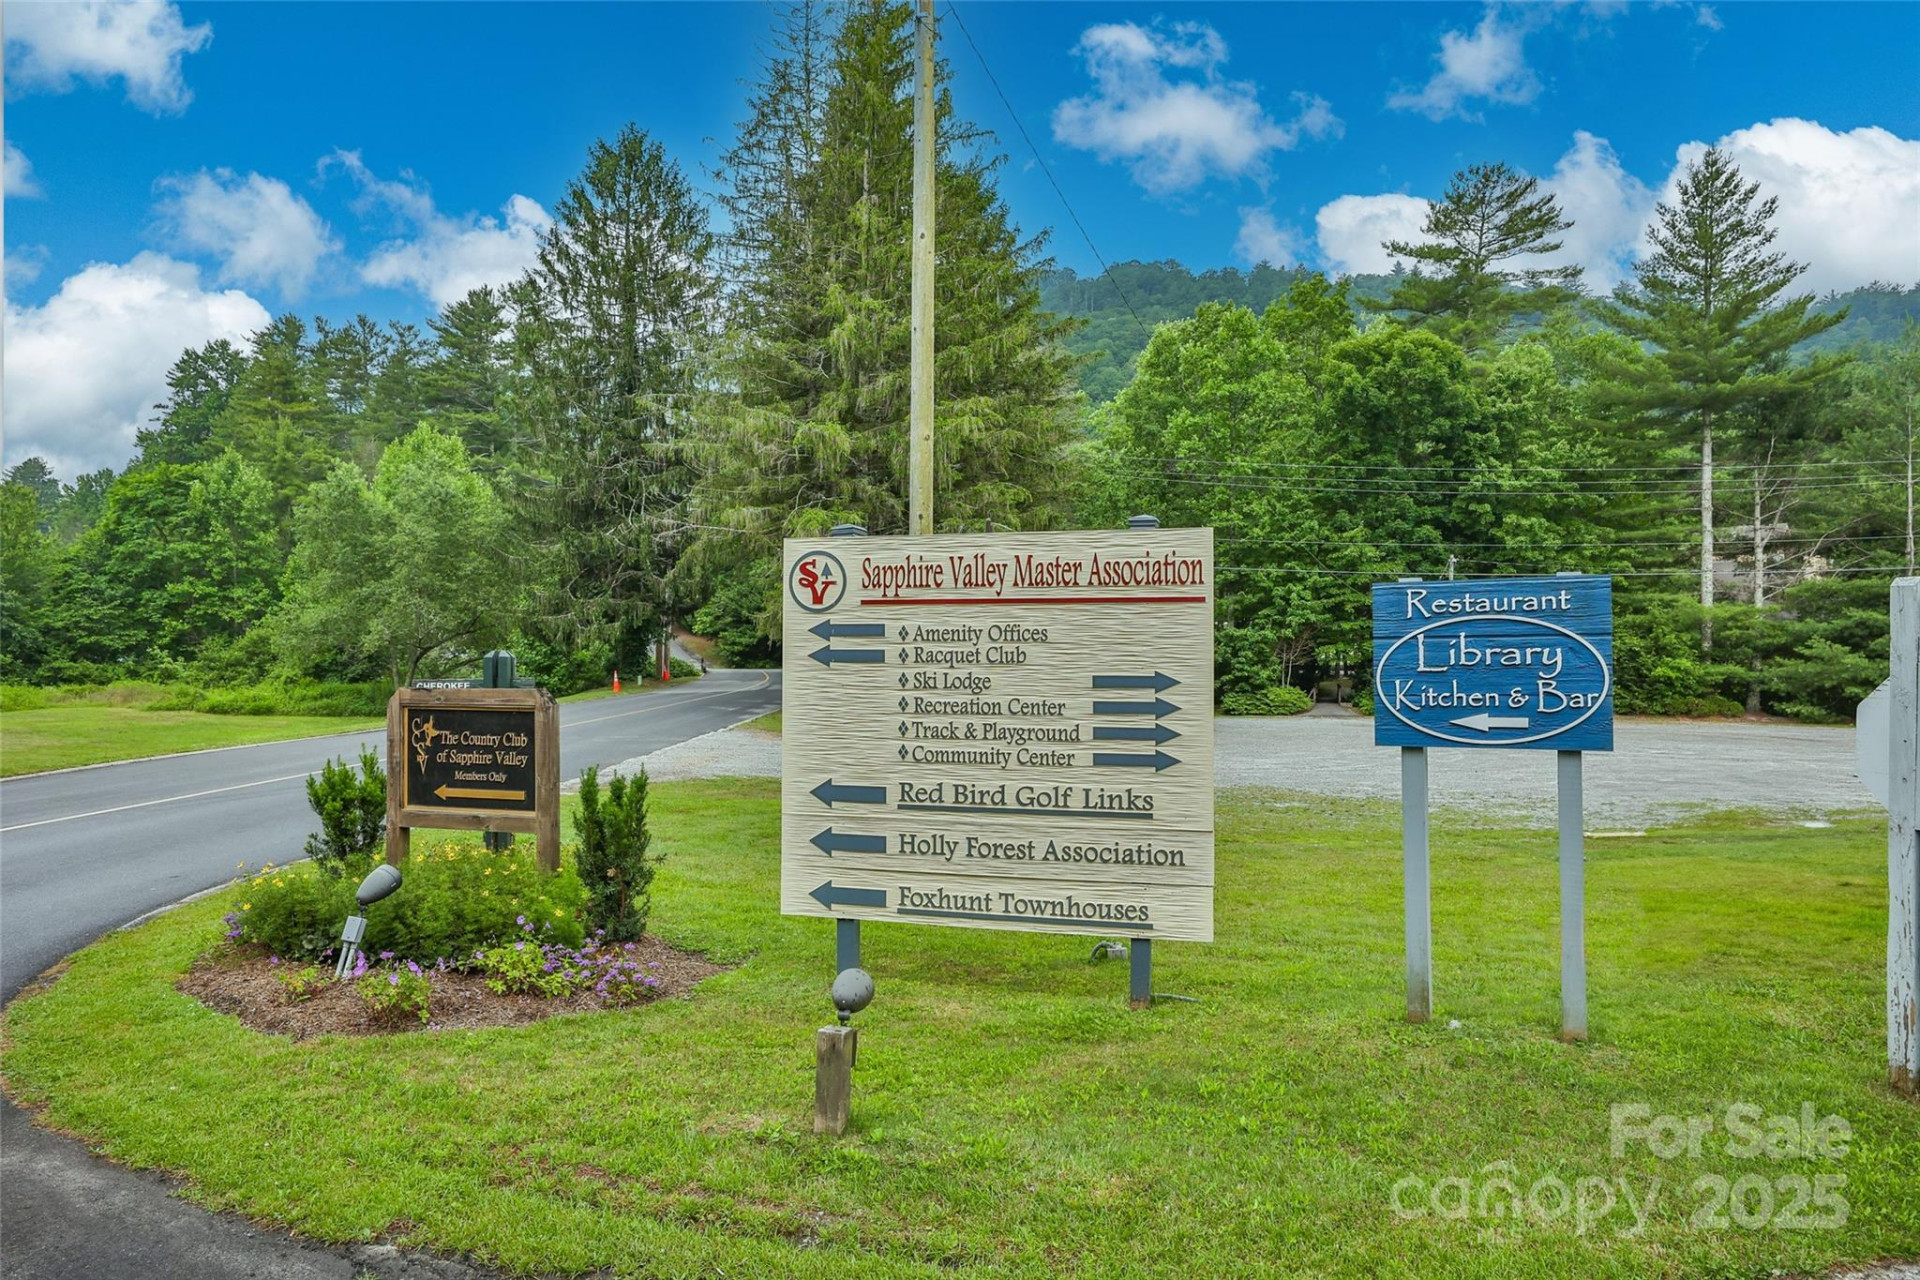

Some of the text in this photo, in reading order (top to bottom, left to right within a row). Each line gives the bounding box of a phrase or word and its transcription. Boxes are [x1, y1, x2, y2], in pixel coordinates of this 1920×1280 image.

[861, 550, 1205, 597] Sapphire Valley Master Association
[1406, 589, 1571, 619] Restaurant
[913, 625, 1048, 645] Amenity Offices
[913, 646, 1027, 668] Racquet Club
[1417, 632, 1563, 679] Library
[913, 672, 991, 694] Ski Lodge
[1395, 679, 1600, 713] Kitchen & Bar
[913, 698, 1066, 717] Recreation Center
[439, 730, 528, 748] The Country Club
[912, 721, 1080, 744] Track & Playground
[436, 749, 528, 767] of Sapphire Valley
[912, 746, 1075, 768] Community Center
[454, 770, 507, 783] Members Only
[899, 782, 1154, 811] Red Bird Golf Links
[898, 833, 1185, 867] Holly Forest Association
[898, 886, 1149, 921] Foxhunt Townhouses
